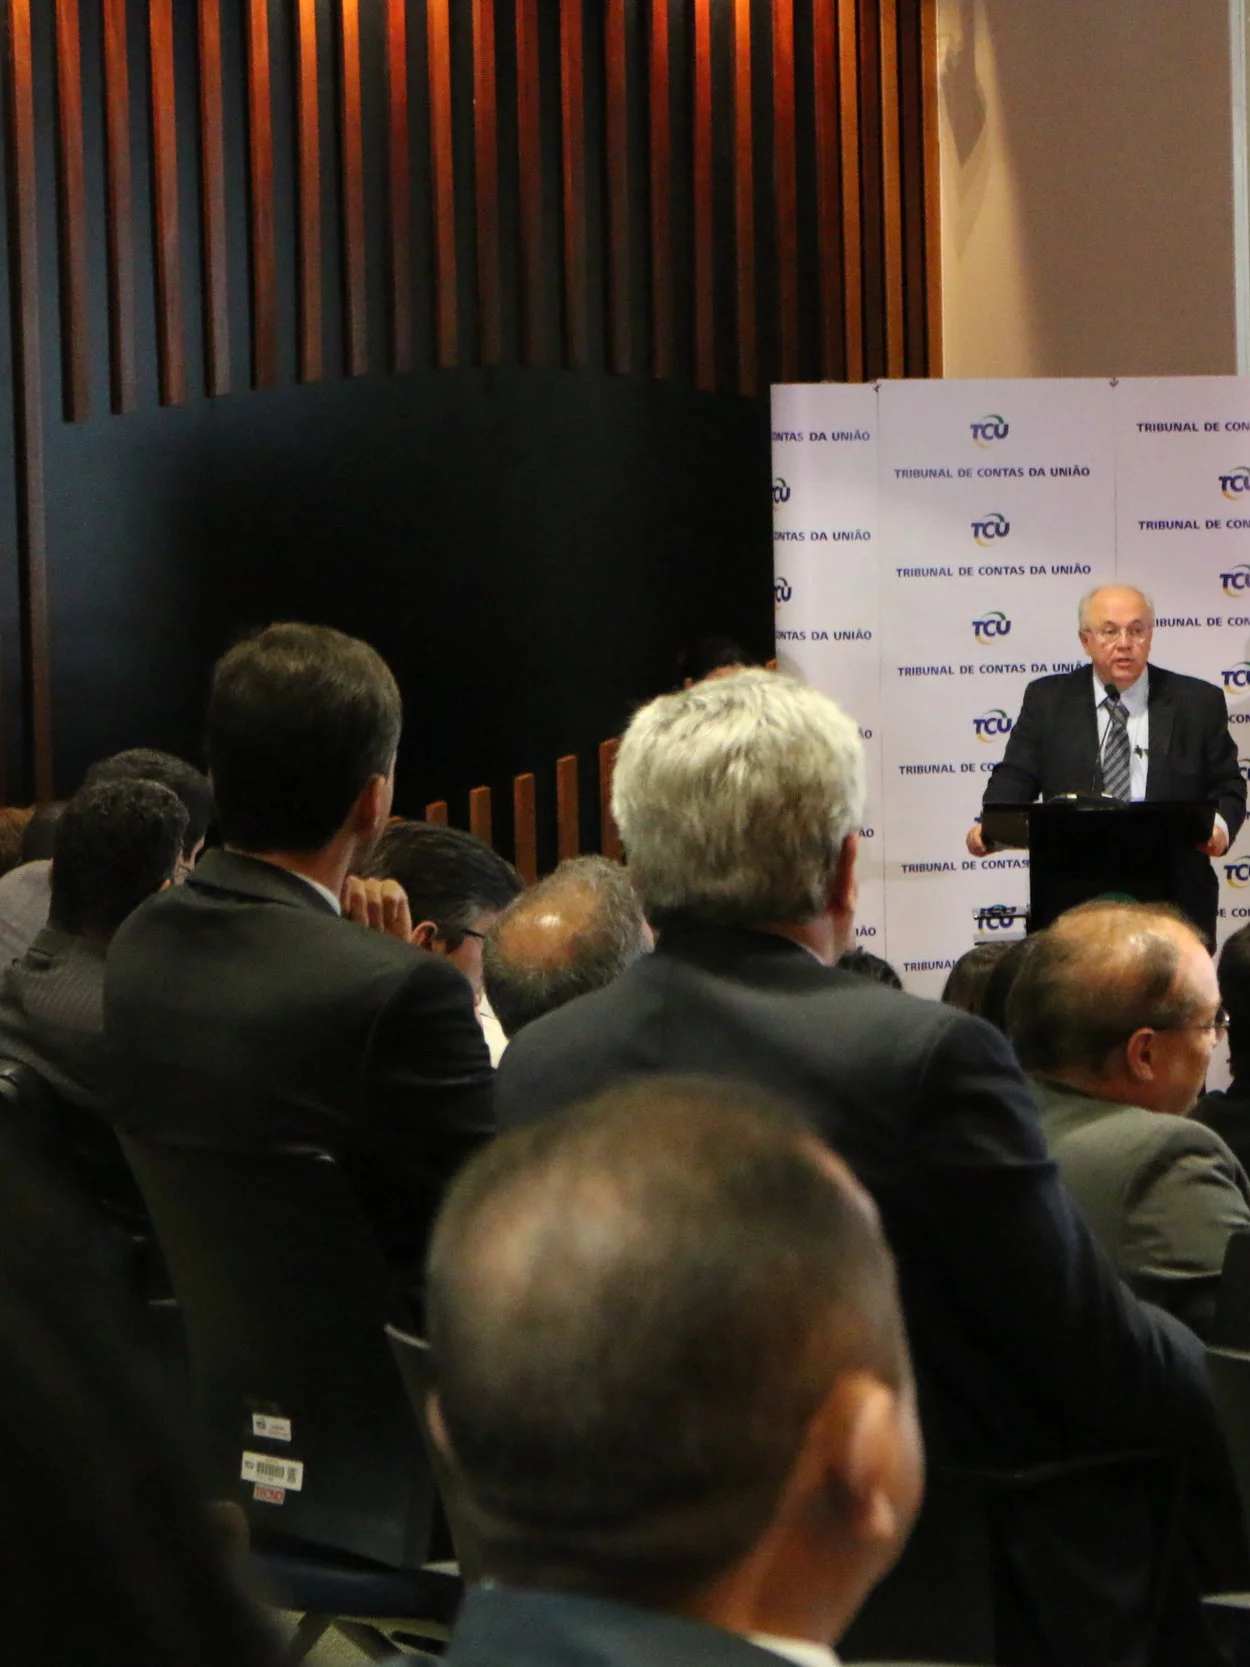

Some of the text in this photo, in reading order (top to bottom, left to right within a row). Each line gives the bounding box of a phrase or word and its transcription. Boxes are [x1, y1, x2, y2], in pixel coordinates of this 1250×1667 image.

[970, 422, 1009, 441] TCU
[1137, 422, 1199, 432] TRIBUNAL
[1204, 422, 1220, 432] DE
[772, 429, 870, 441] ONTAS DA UNIÃO
[895, 465, 1090, 479] TRIBUNAL DE CONTAS DA UNIÃO
[972, 522, 1010, 539] TCU
[1138, 520, 1200, 530] TRIBUNAL
[1206, 520, 1221, 529] DE
[774, 529, 871, 541] ONTAS DA UNIÃO
[896, 563, 1091, 578] TRIBUNAL DE CONTAS DA UNIÃO
[972, 619, 1011, 637] TCU
[1155, 618, 1201, 627] IBUNAL
[1207, 617, 1222, 626] DE
[775, 628, 872, 641] ONTAS DA UNIÃO
[898, 660, 1082, 676] TRIBUNAL DE CONTAS DA UNIÃ
[973, 718, 1012, 735] TCU
[899, 764, 955, 775] TRIBUNAL
[961, 764, 975, 773] DE
[901, 862, 956, 874] TRIBUNAL
[962, 861, 976, 870] DE
